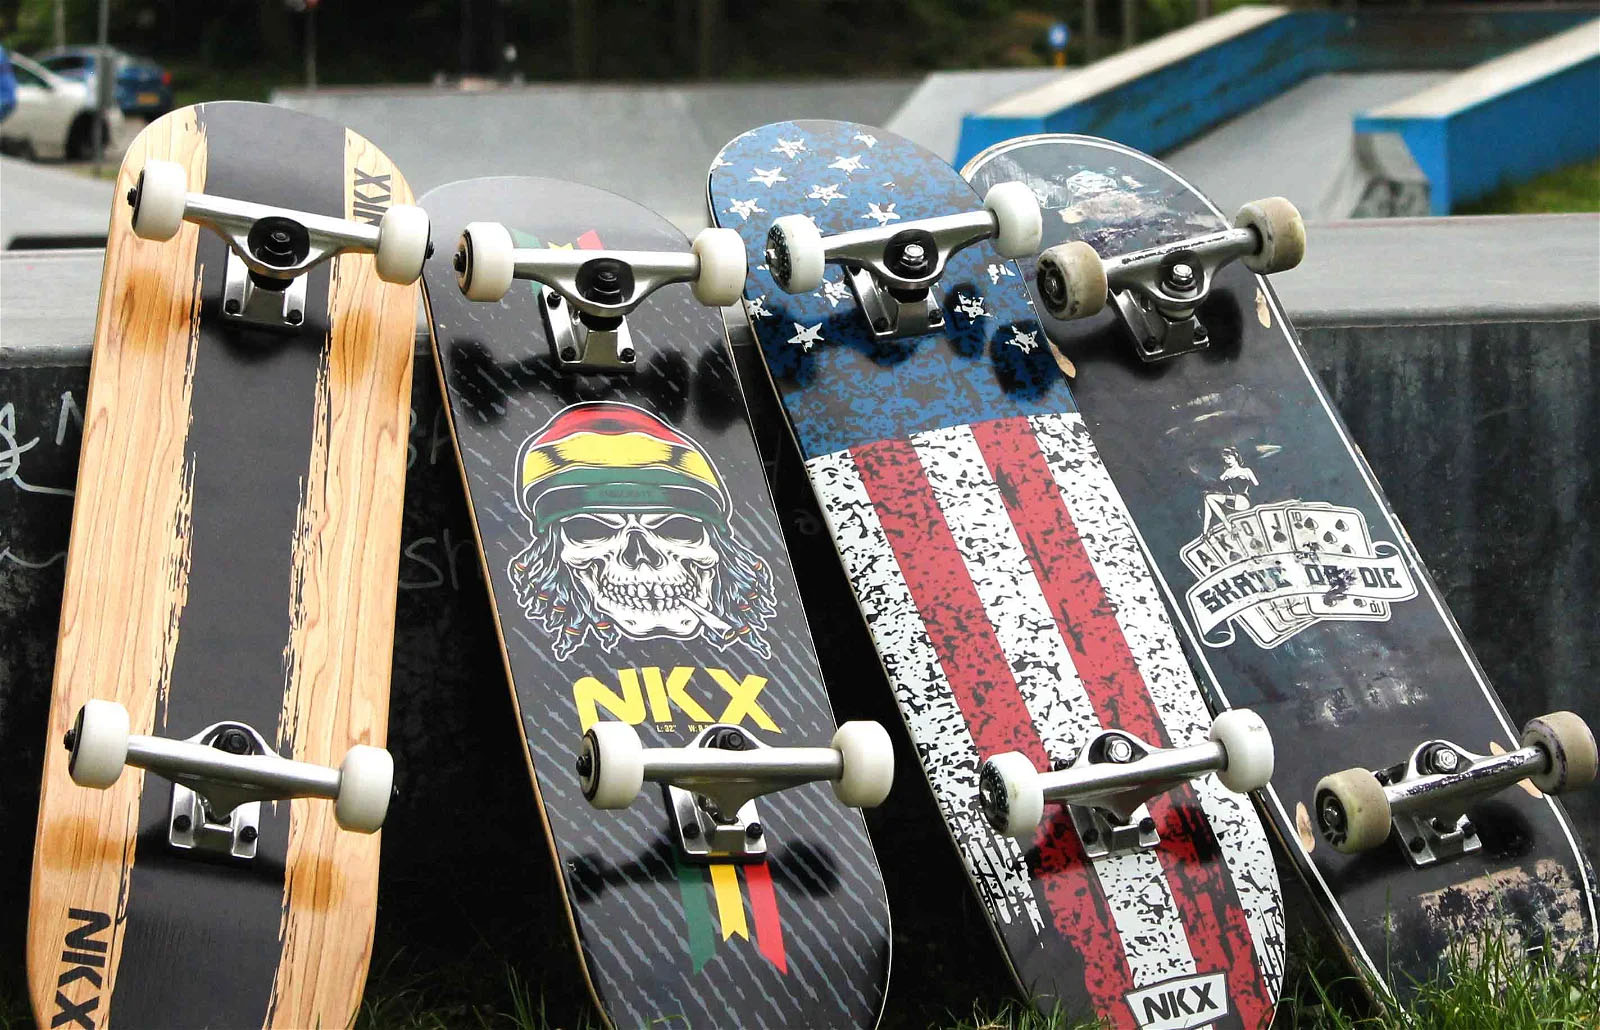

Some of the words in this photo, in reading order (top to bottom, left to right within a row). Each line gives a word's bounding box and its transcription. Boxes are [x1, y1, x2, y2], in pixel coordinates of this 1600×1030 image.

[1196, 549, 1215, 567] A
[1213, 533, 1234, 552] K
[1271, 513, 1281, 530] J
[1196, 567, 1293, 615] SKATE
[1357, 566, 1402, 588] DIE
[572, 666, 783, 735] NKX
[51, 907, 112, 1030] NKX
[1142, 982, 1219, 1024] NKX
